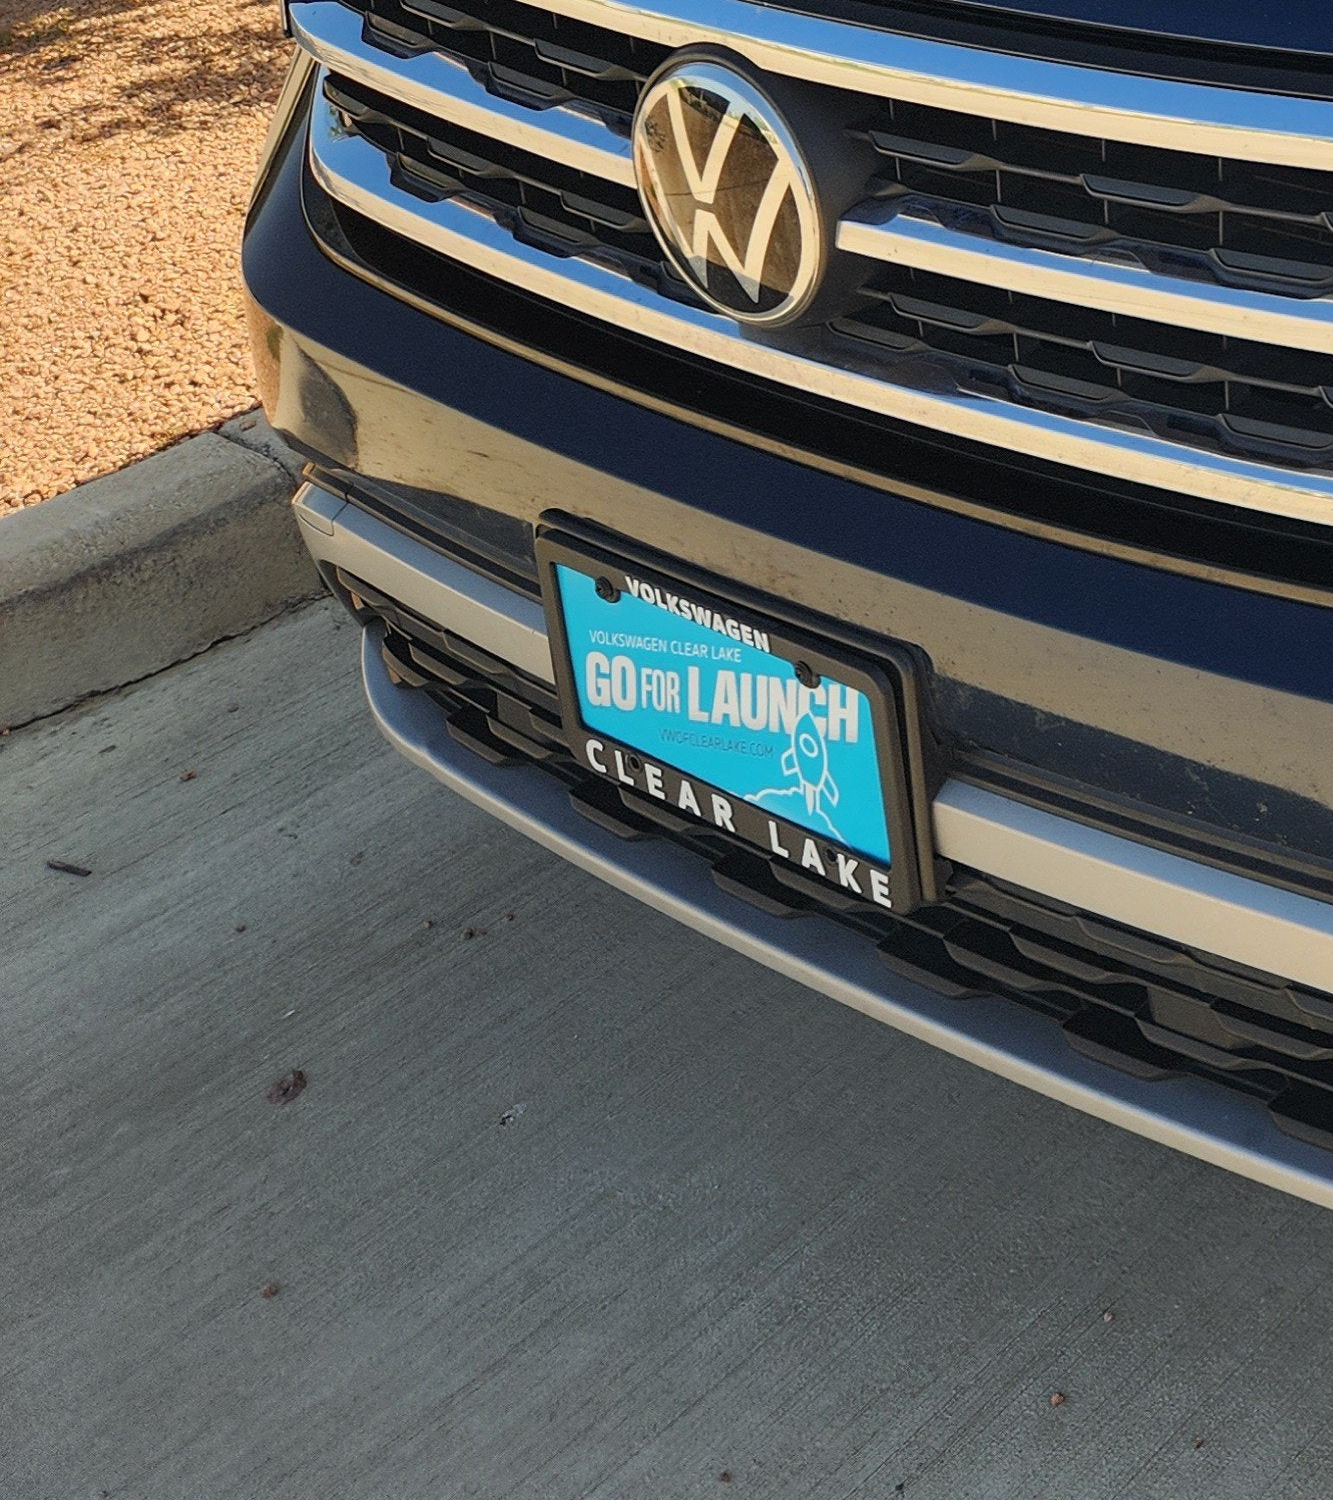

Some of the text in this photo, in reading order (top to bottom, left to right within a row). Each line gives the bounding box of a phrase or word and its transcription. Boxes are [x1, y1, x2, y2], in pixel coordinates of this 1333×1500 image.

[636, 70, 806, 306] VW
[588, 629, 742, 663] VOLKSWAGEN CLEAR LAKE
[624, 575, 771, 654] VOLKSWAGEN
[585, 651, 860, 744] GO FOR LAUNCH
[585, 740, 893, 908] CLEAR LAKE
